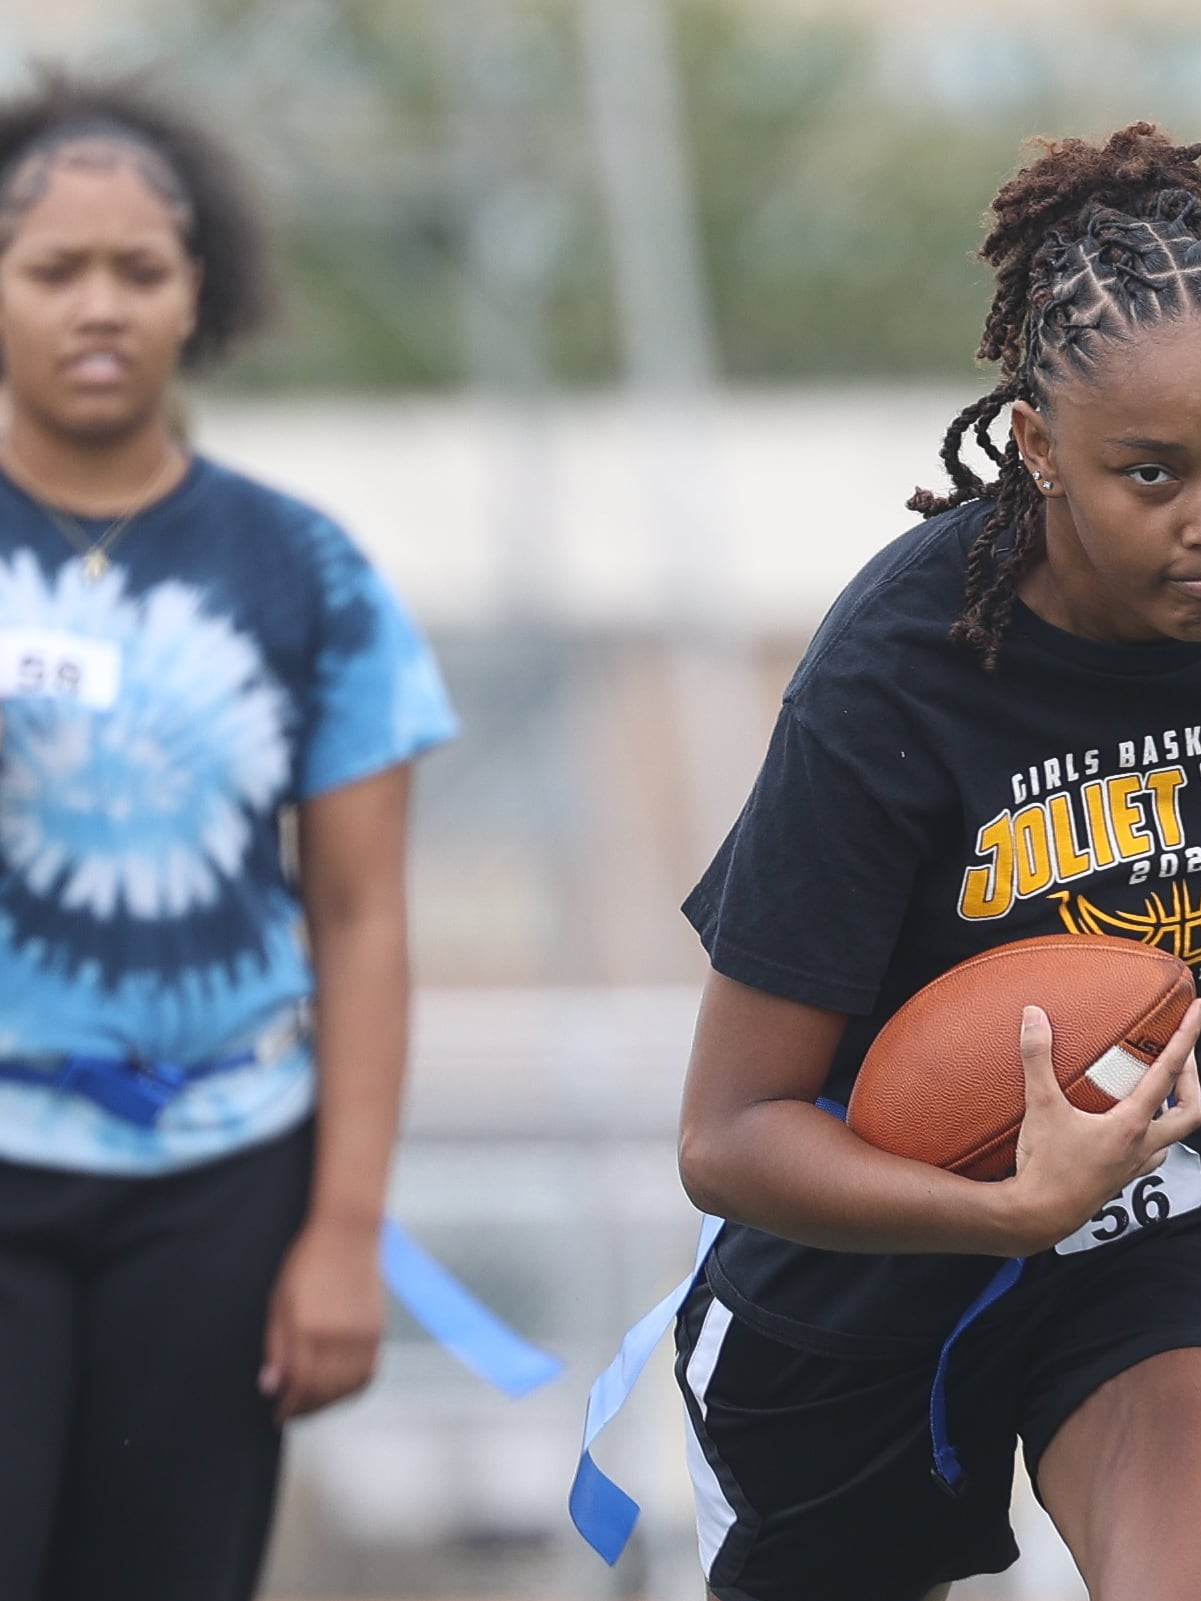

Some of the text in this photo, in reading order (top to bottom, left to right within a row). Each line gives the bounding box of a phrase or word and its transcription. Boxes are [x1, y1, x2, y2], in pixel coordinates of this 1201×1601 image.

[1011, 749, 1100, 804] GIRLS
[957, 765, 1187, 921] JOLIET
[1091, 1174, 1170, 1241] 56
